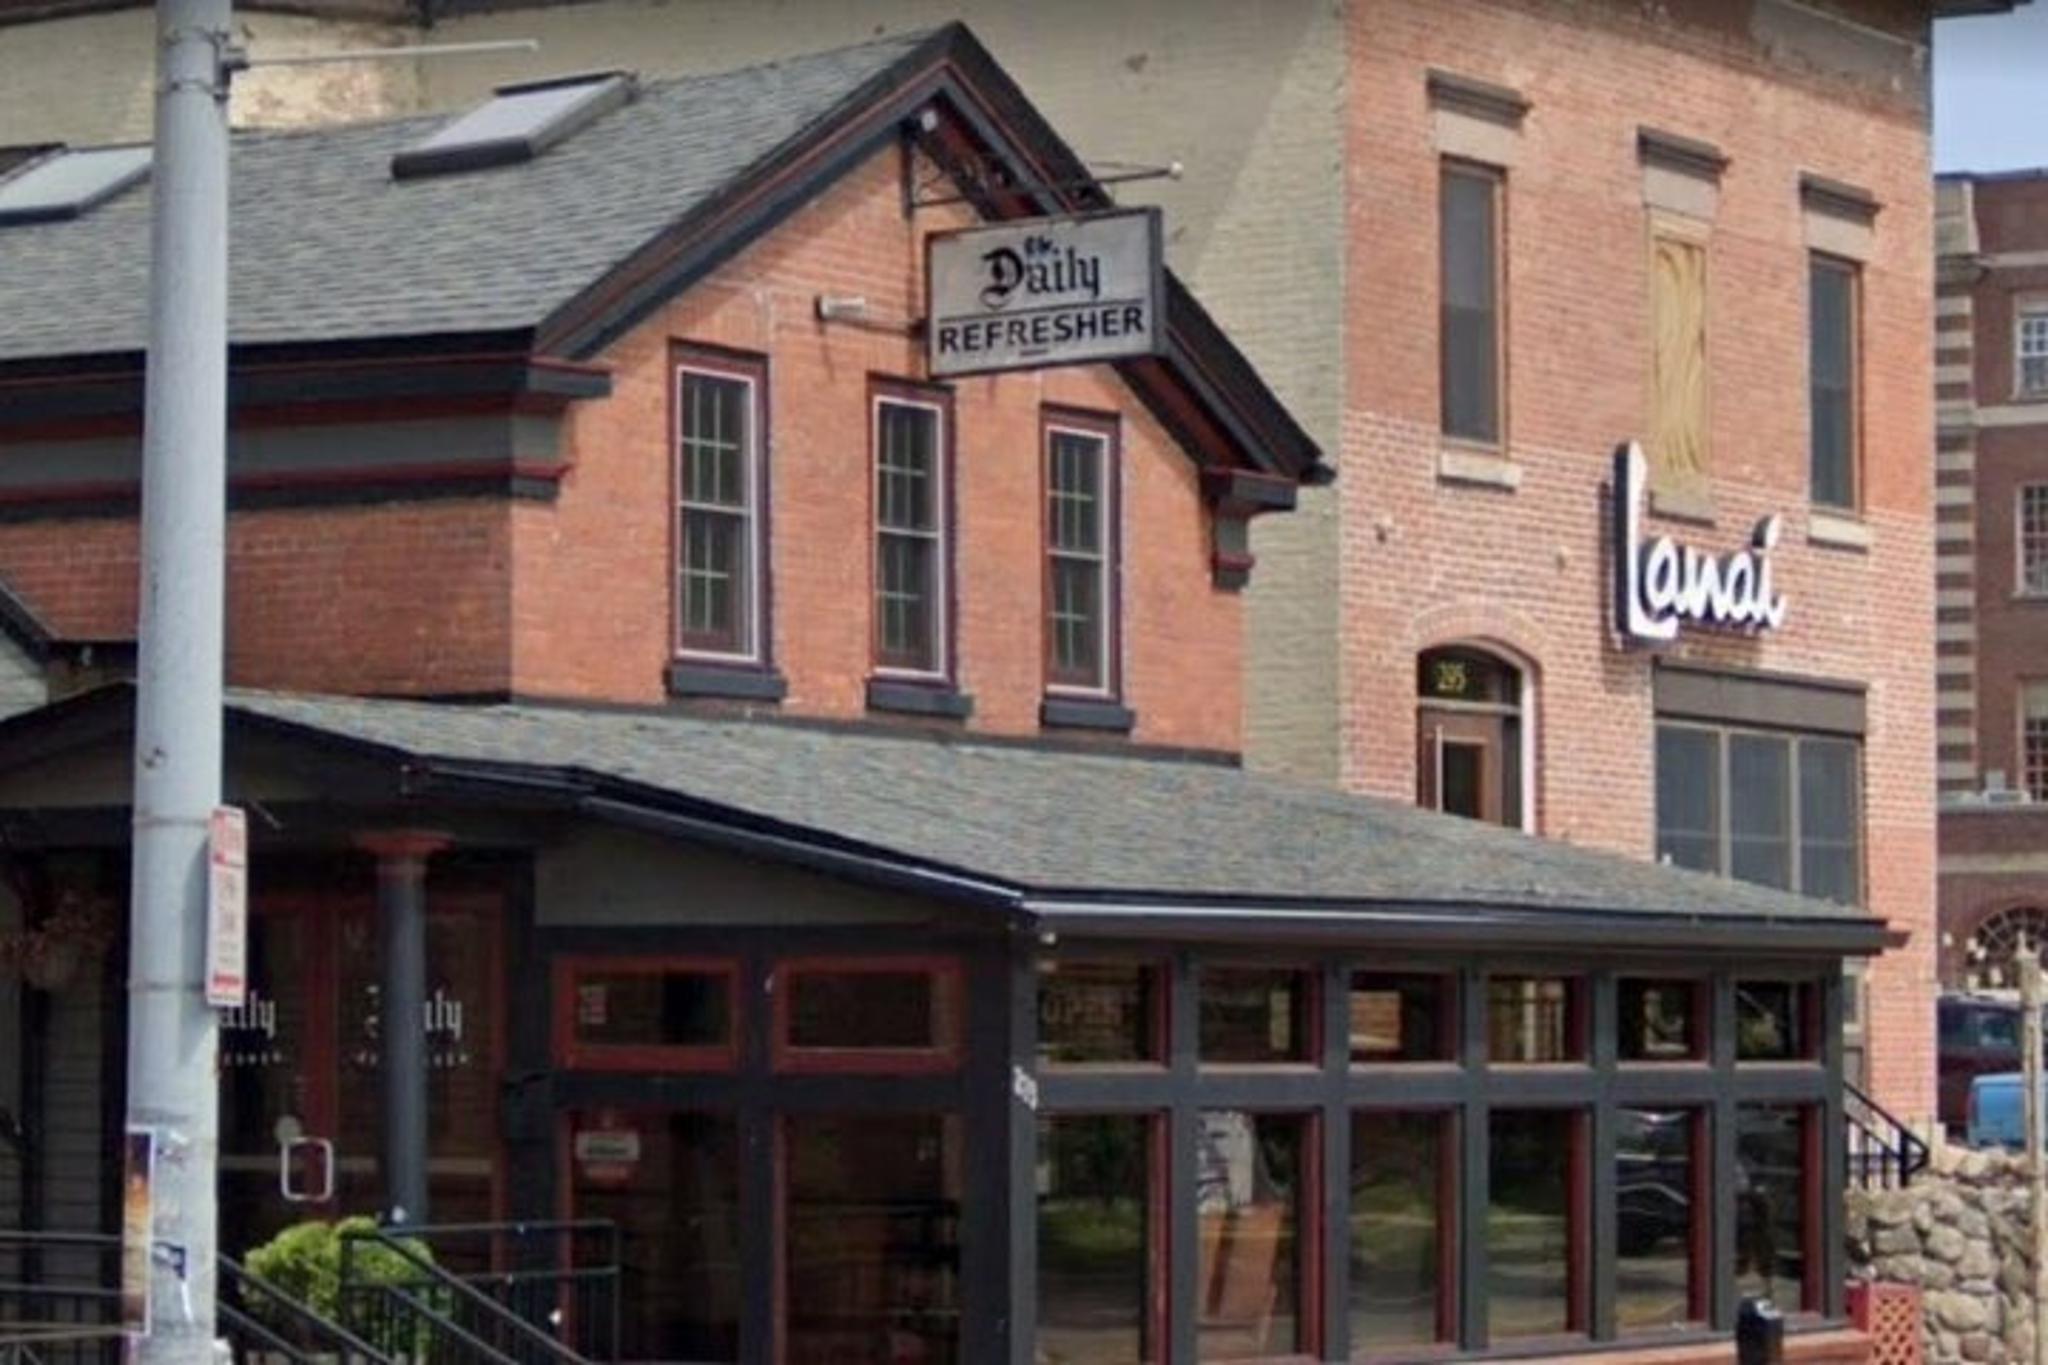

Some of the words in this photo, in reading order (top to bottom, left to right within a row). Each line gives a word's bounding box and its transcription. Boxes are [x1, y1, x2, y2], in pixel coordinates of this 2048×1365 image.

[979, 246, 1100, 308] Daily
[938, 306, 1144, 354] REFRESHER
[1614, 440, 1786, 645] Lanai
[220, 988, 275, 1039] aily
